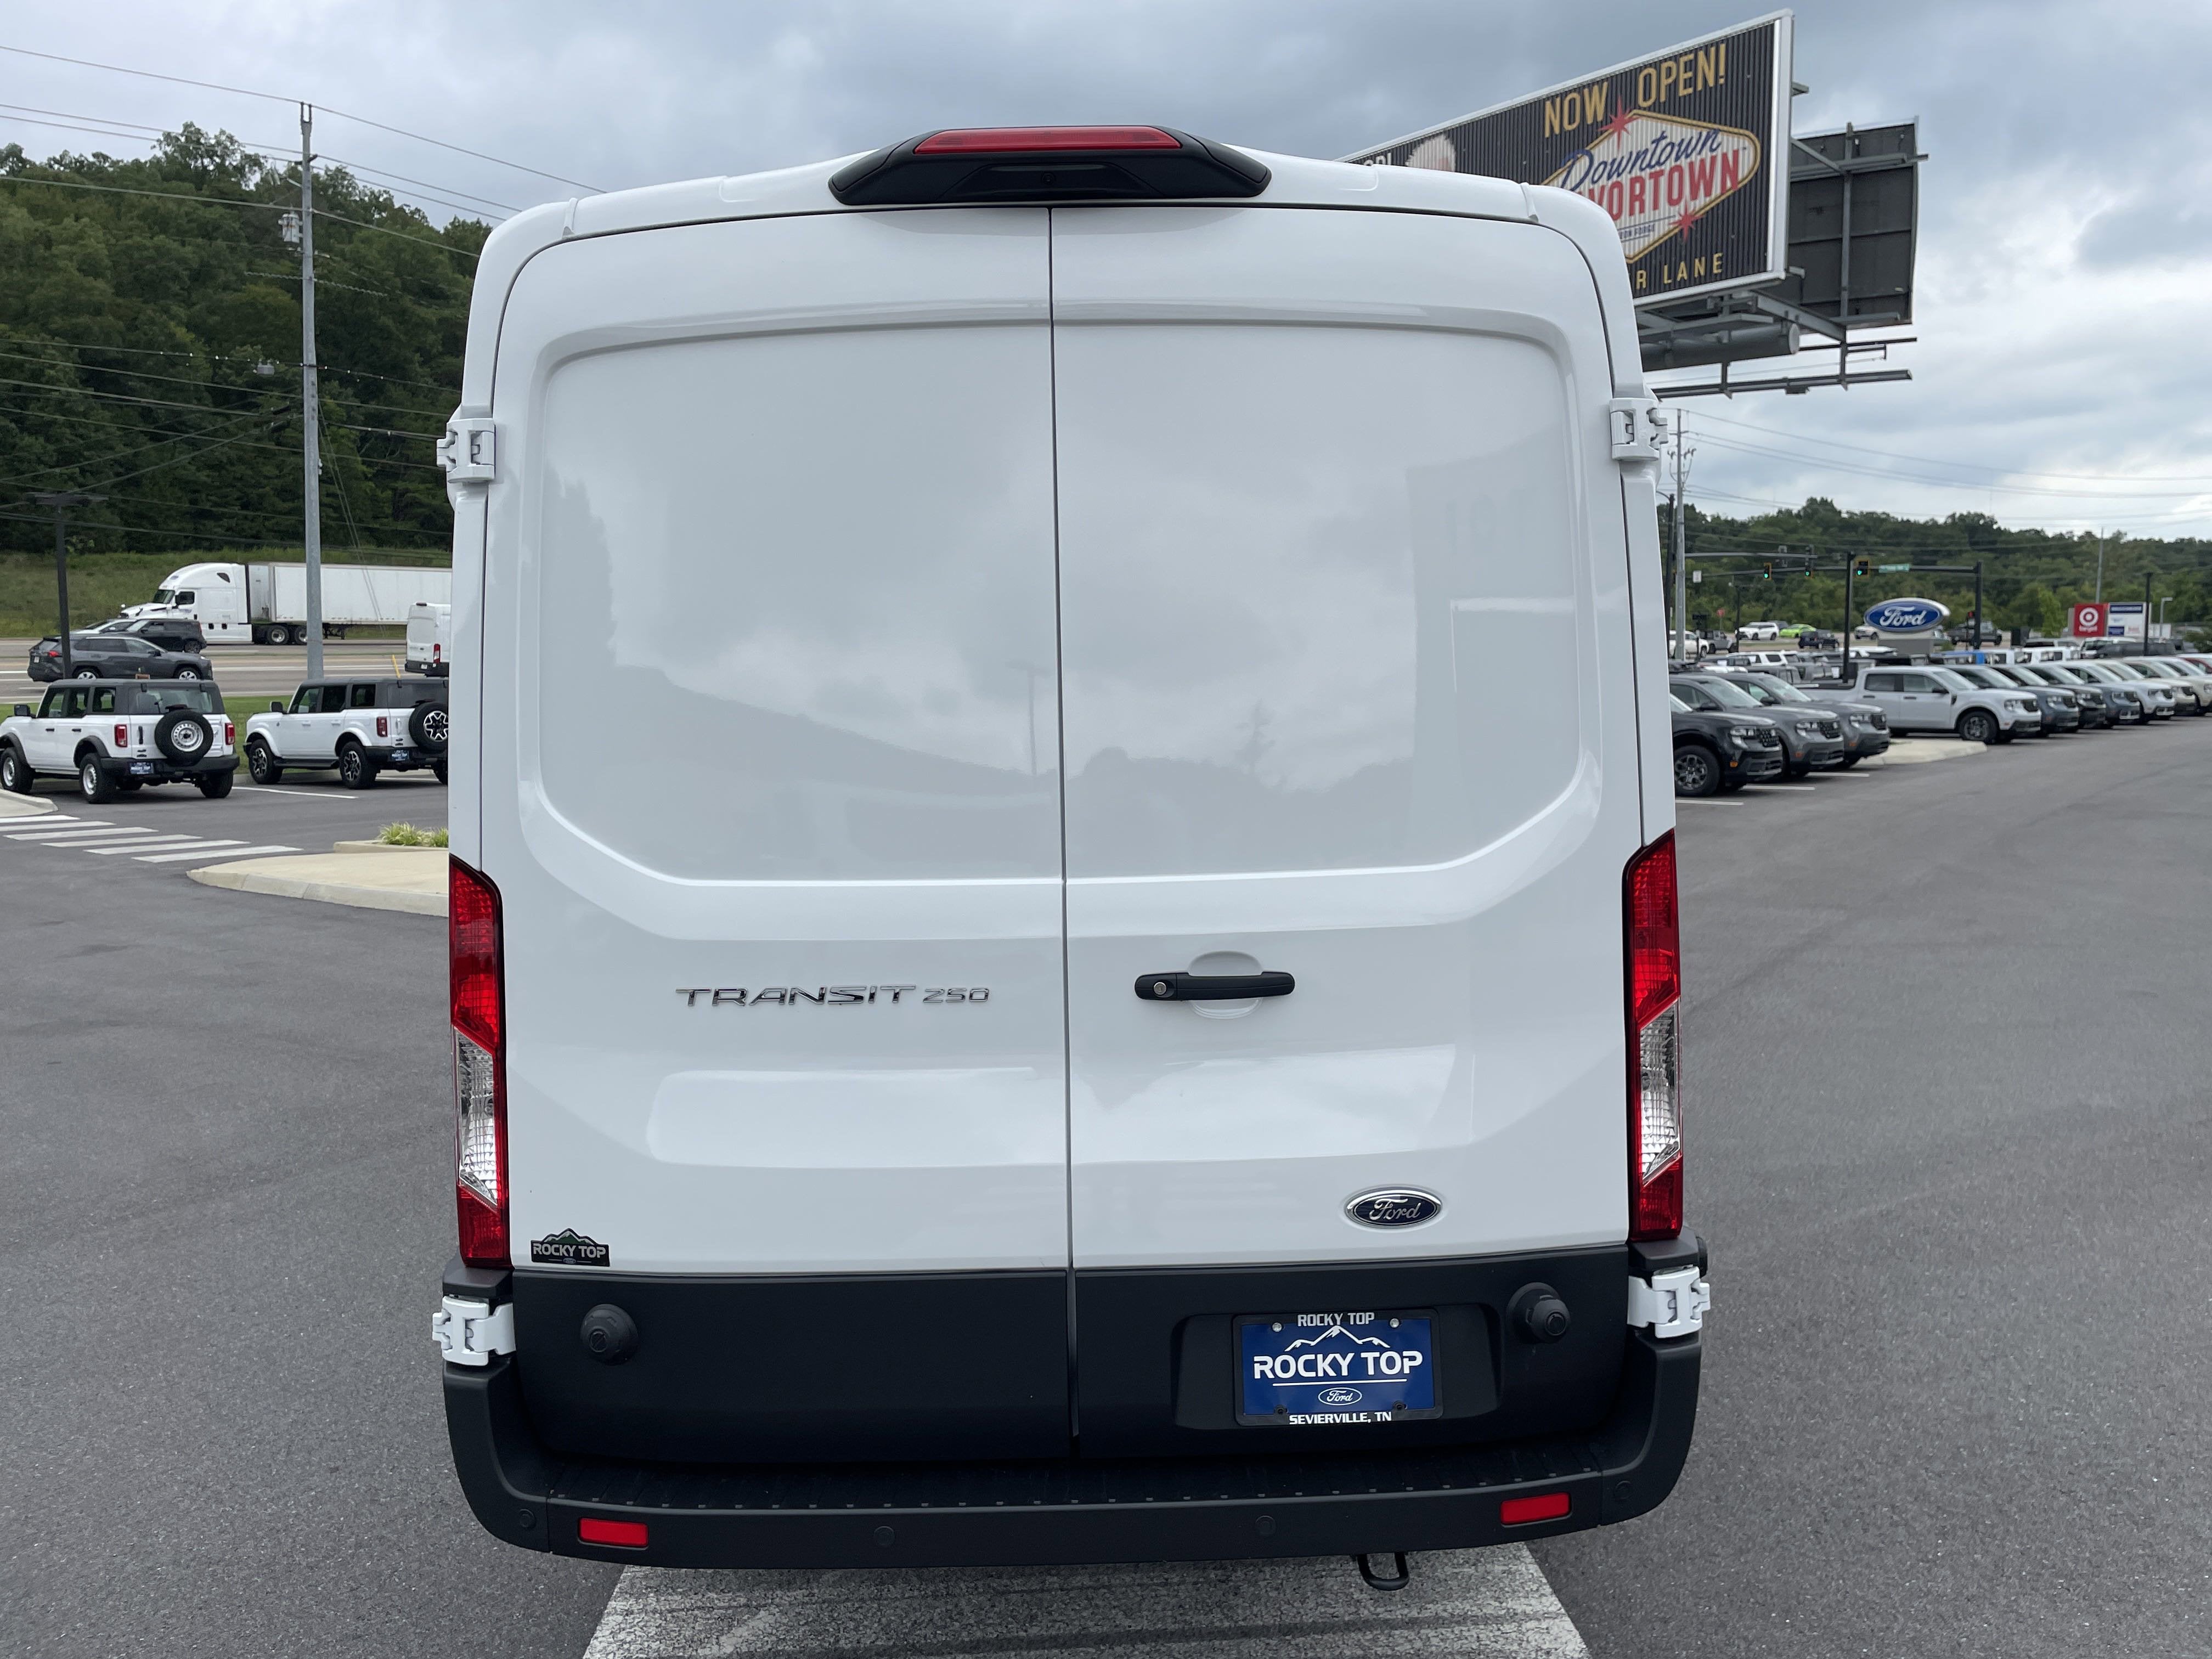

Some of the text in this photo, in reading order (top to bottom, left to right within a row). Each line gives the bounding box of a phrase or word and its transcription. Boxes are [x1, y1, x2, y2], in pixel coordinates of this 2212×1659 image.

[1544, 43, 1726, 138] NOW OPEN!
[1561, 129, 1722, 191] Downtown
[1577, 149, 1739, 221] VORTOWN
[1663, 252, 1723, 285] LANE
[1880, 606, 1928, 627] Ford
[675, 985, 989, 1006] TRANSIT 250
[1369, 1198, 1421, 1220] Ford
[533, 1243, 606, 1259] ROCKY TOP
[1297, 1312, 1375, 1327] ROCKY TOP
[1254, 1351, 1423, 1379] ROCKY TOP
[1327, 1389, 1353, 1402] Ford
[1289, 1411, 1392, 1425] SEVIERVILLE, TN
